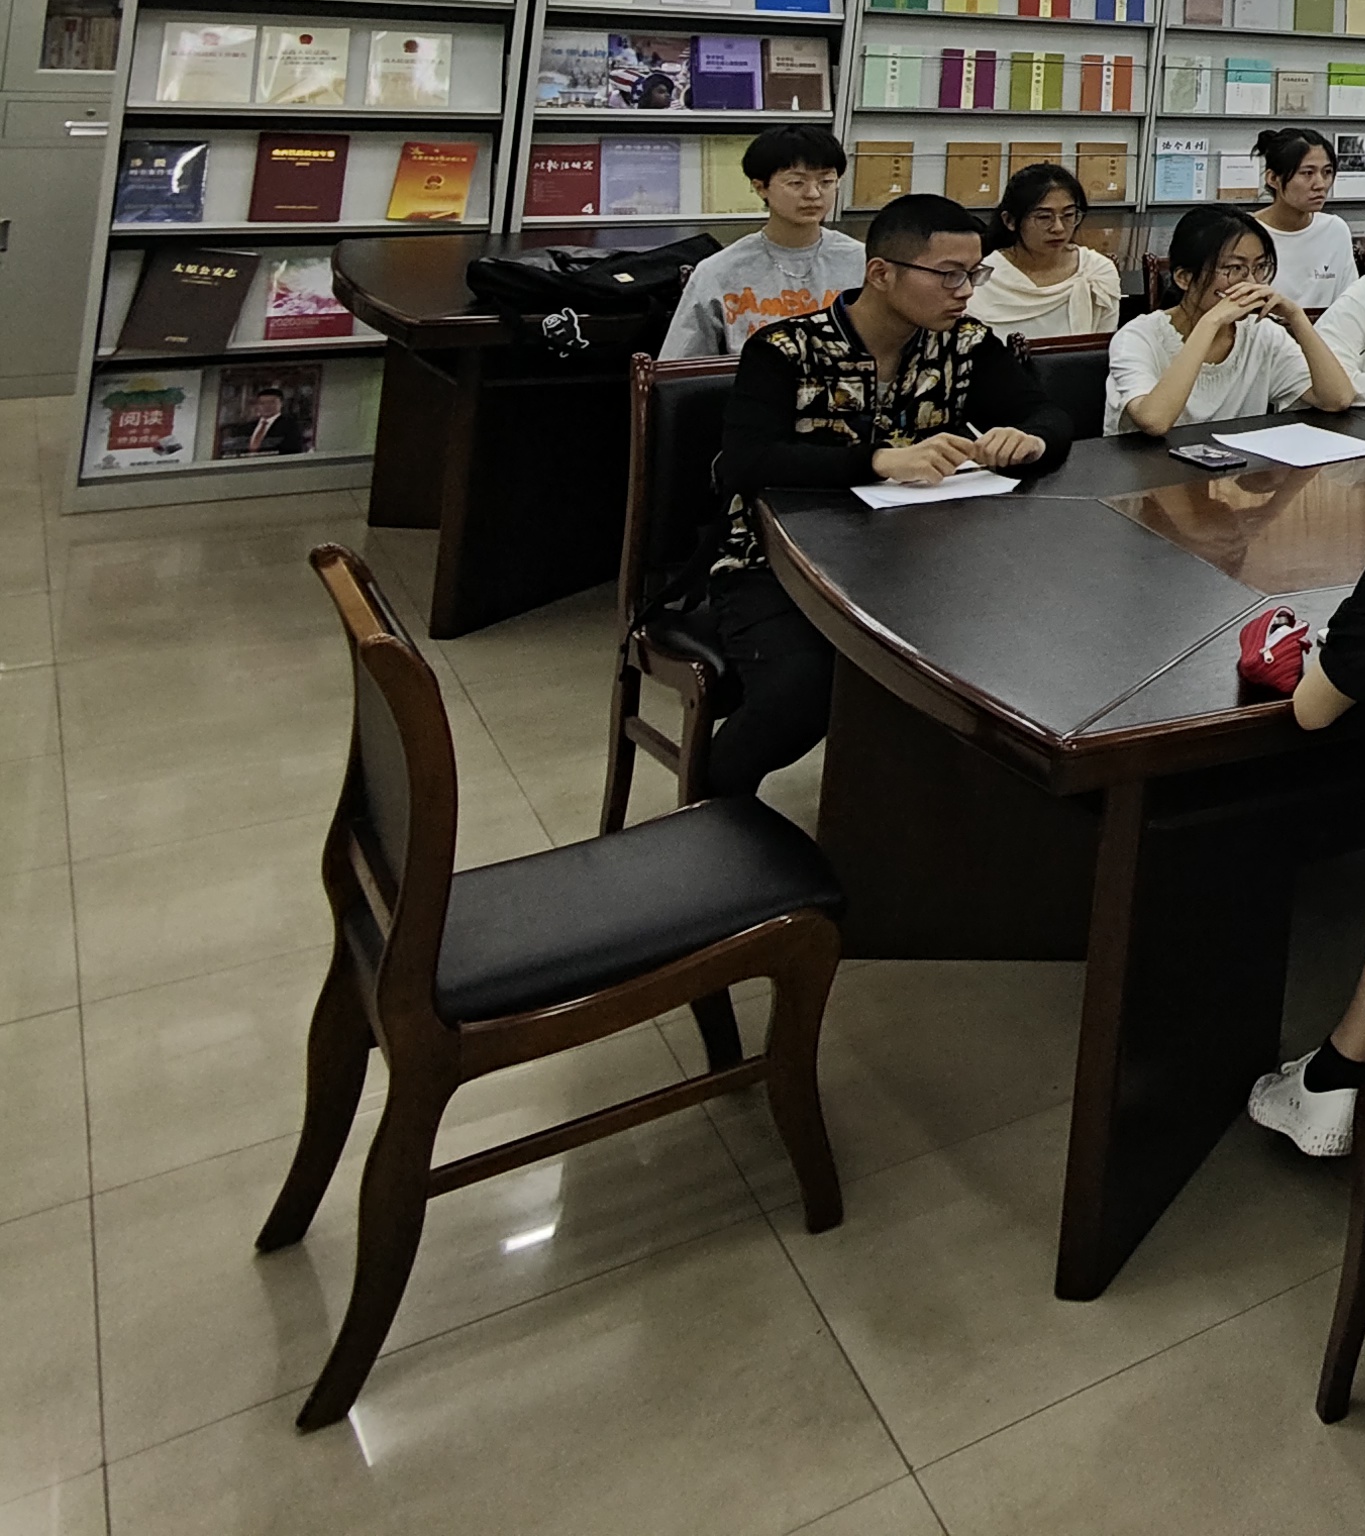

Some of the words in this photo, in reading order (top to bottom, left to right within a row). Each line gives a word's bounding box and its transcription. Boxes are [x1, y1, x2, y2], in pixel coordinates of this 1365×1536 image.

[1162, 140, 1205, 151] 法令月刊
[1195, 163, 1205, 171] 12
[581, 203, 594, 214] 4
[172, 263, 239, 279] 太原公安志
[119, 410, 164, 427] 阅读
